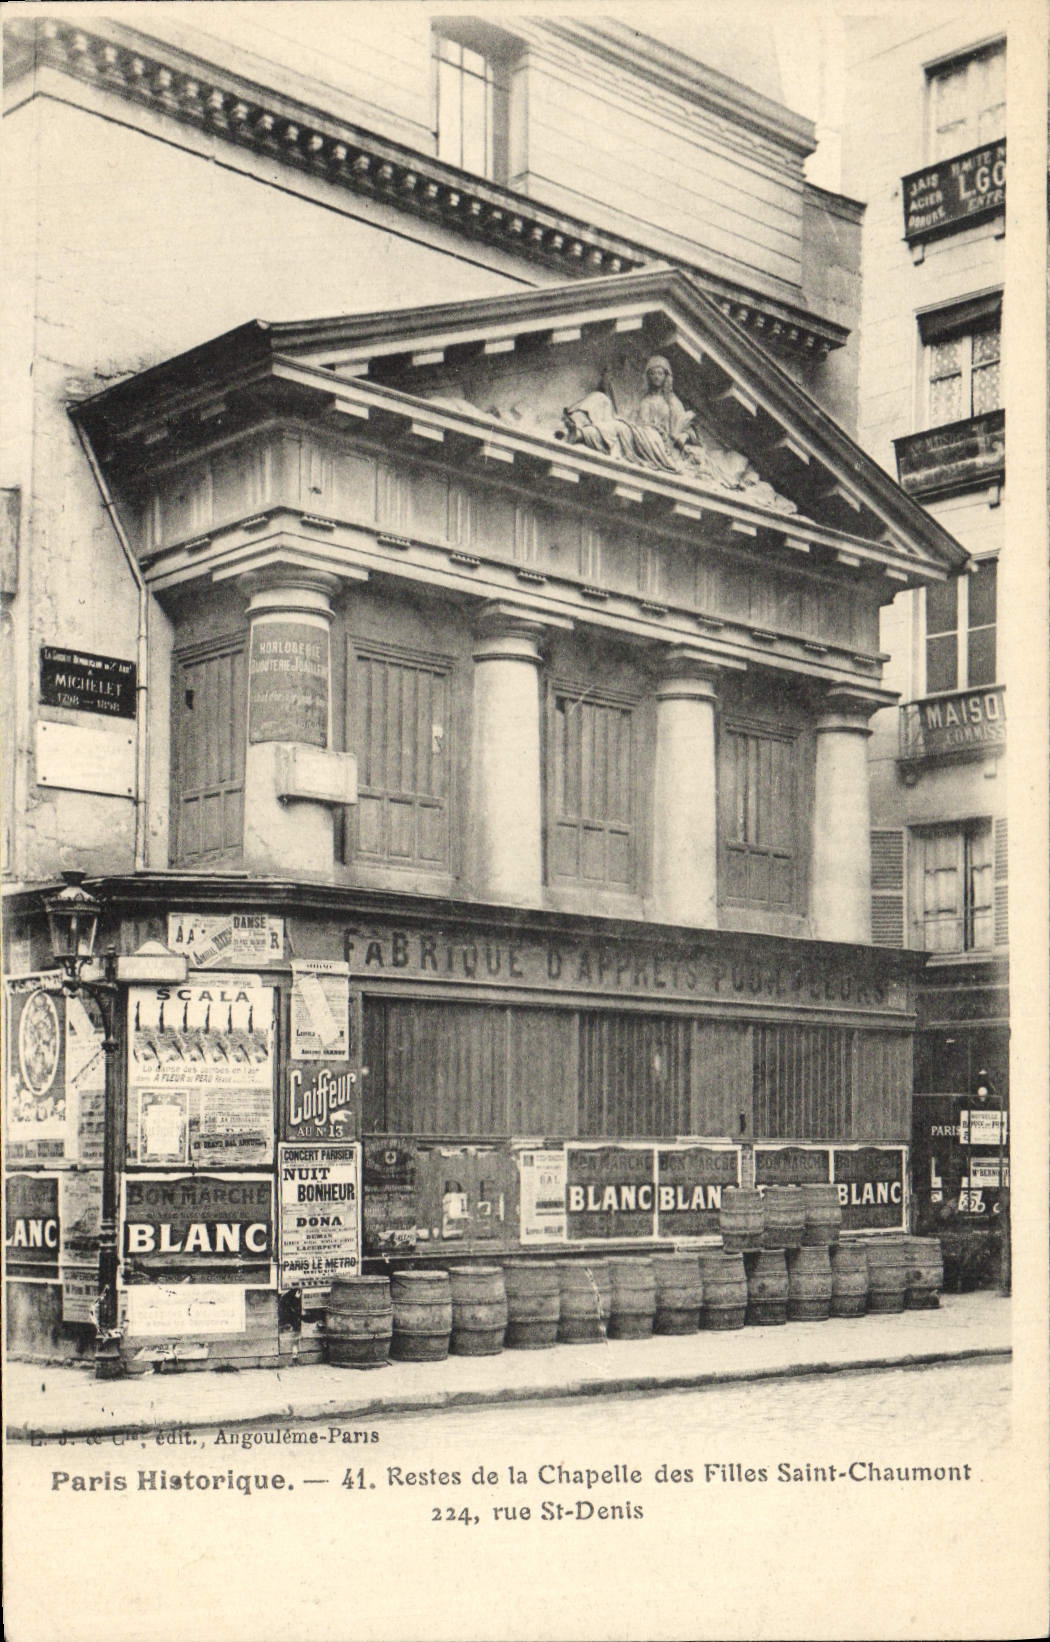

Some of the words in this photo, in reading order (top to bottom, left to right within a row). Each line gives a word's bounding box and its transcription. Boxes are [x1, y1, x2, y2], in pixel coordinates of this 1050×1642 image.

[55, 672, 122, 698] MICHELET
[925, 693, 1000, 729] MAISO
[233, 916, 267, 929] DANSE
[342, 926, 525, 980] FABRIQUE
[156, 988, 250, 1002] SCALA
[290, 1069, 356, 1126] Coiffeur
[298, 1127, 312, 1136] AU
[329, 1125, 344, 1138] 13
[284, 1150, 319, 1161] CONCERT
[321, 1149, 354, 1160] PARISIEN
[283, 1167, 331, 1181] NUIT
[127, 1184, 173, 1206] BON
[297, 1182, 355, 1203] BONHEUR
[569, 1185, 652, 1212] BLANC
[659, 1185, 736, 1211] BLAN
[838, 1181, 901, 1206] BLANC
[296, 1216, 342, 1228] DONA
[127, 1223, 268, 1253] BLANC
[283, 1260, 310, 1272] PARIS
[312, 1260, 323, 1270] LE
